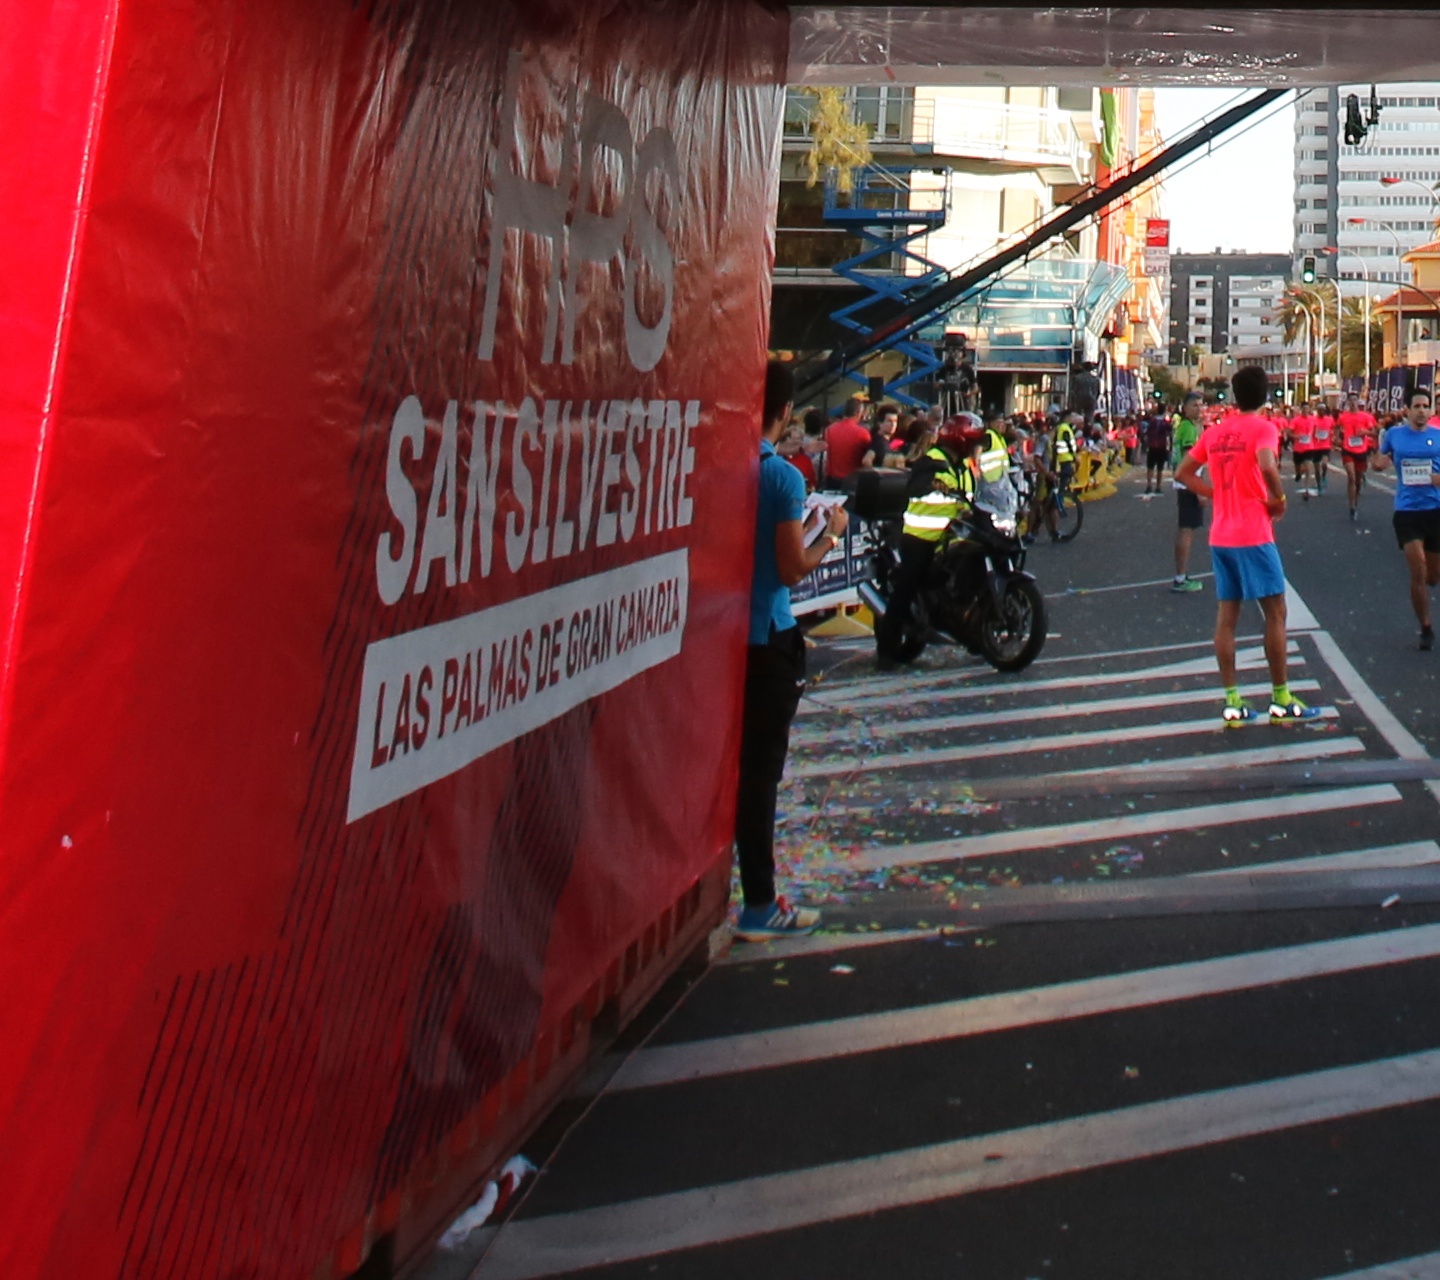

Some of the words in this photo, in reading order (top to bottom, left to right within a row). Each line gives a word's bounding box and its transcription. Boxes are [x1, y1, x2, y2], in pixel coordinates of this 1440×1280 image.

[476, 48, 682, 372] HPS
[376, 394, 500, 606] SAN
[503, 399, 701, 575] SILVESTRE
[369, 663, 433, 768] LAS
[438, 630, 532, 739] PALMAS
[534, 616, 563, 692] DE
[565, 601, 613, 679] GRAN
[615, 577, 680, 654] CANARIA
